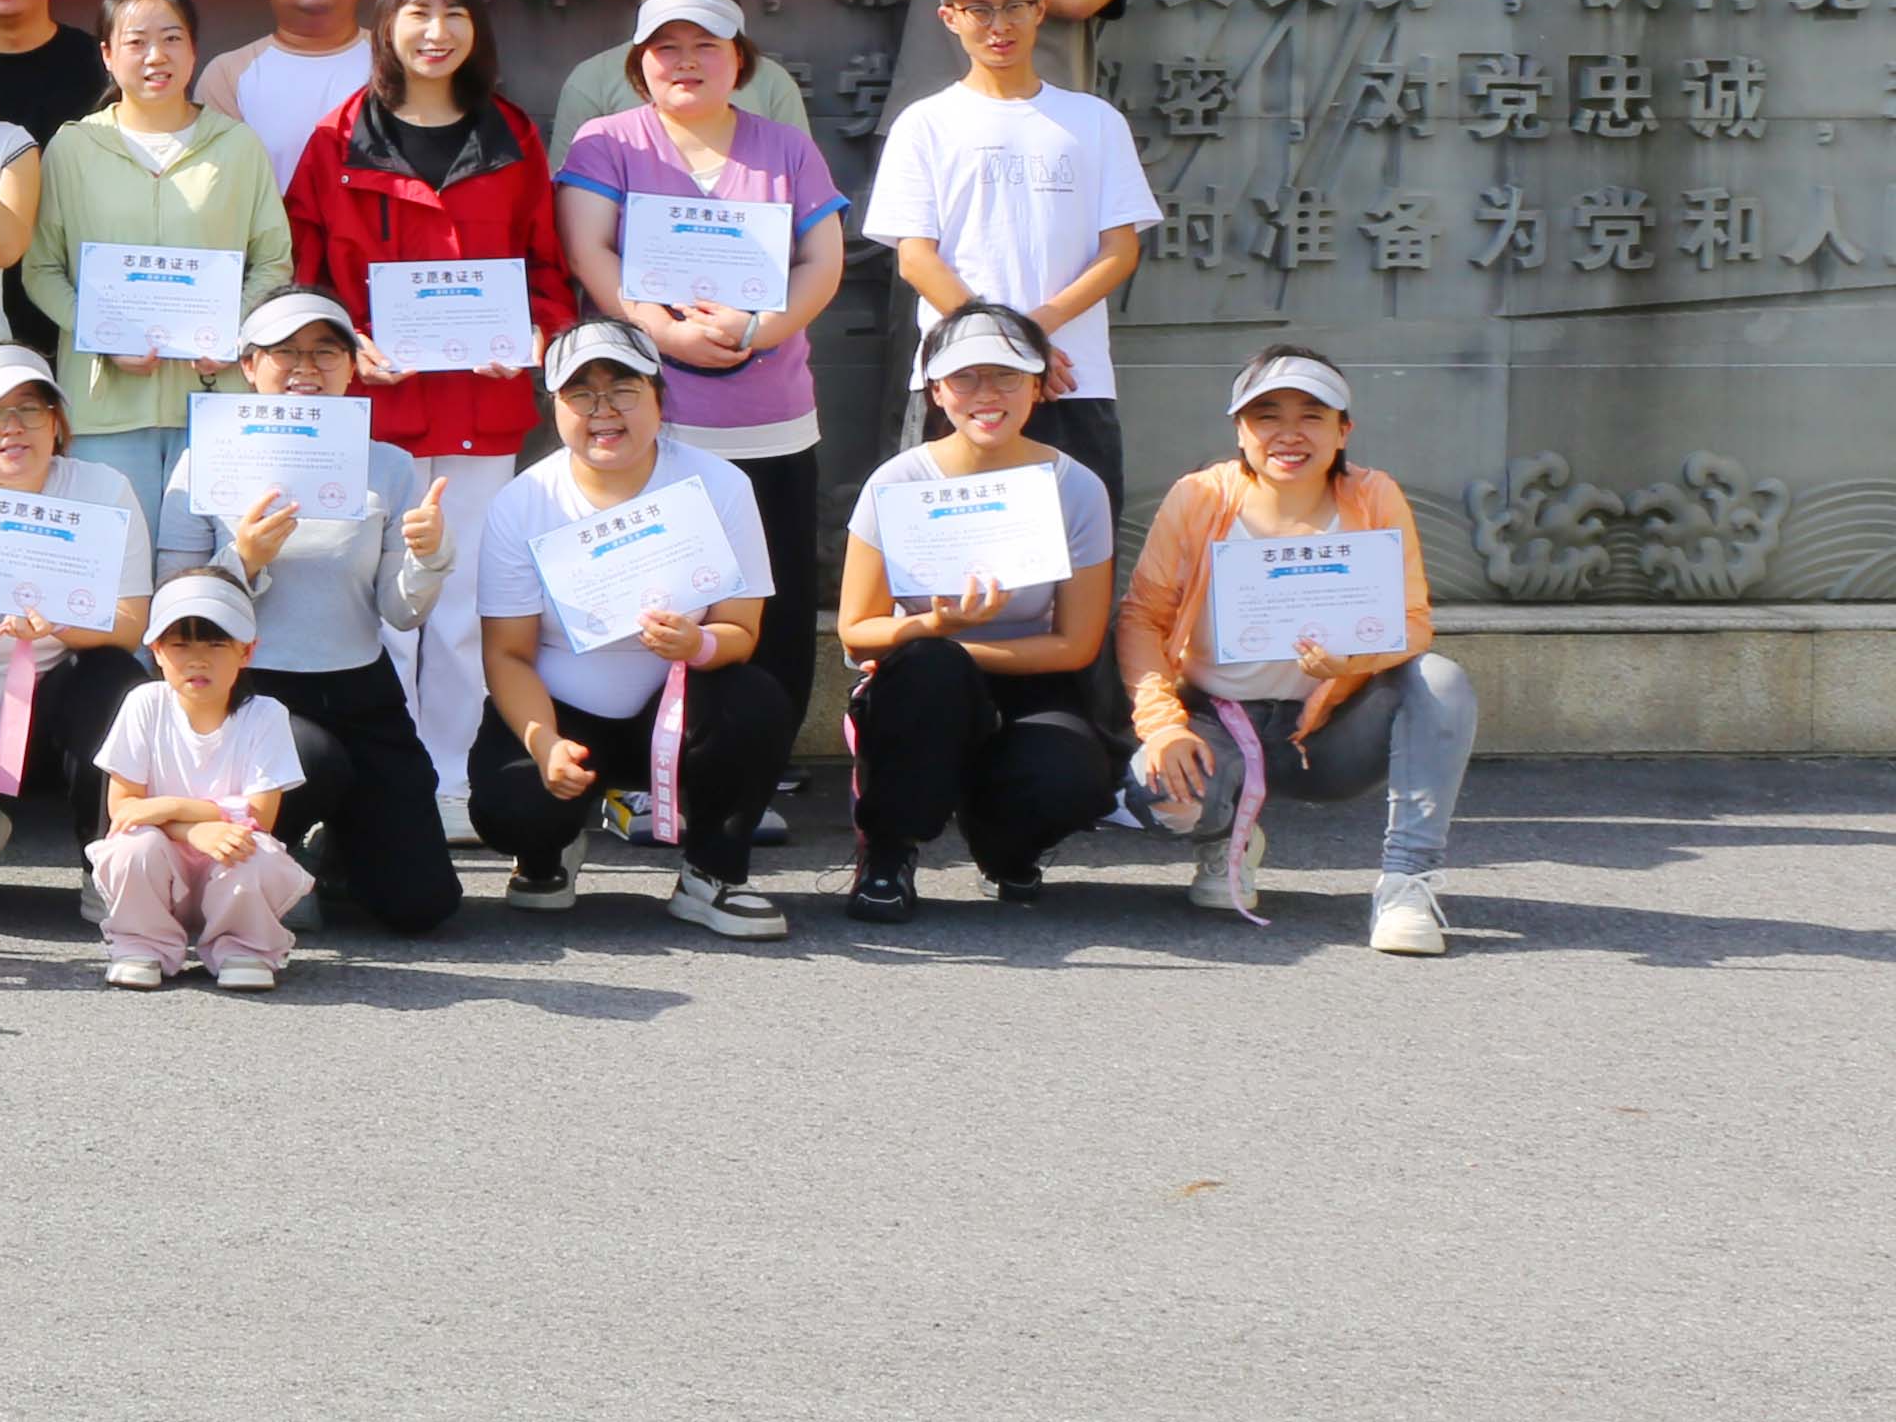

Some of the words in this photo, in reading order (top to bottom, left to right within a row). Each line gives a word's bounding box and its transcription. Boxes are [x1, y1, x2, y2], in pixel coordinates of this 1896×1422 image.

[670, 206, 745, 222] 志愿者证书
[124, 255, 199, 270] 志愿者证书
[412, 270, 483, 284] 志愿者证书
[1263, 545, 1350, 562] 志愿者证书
